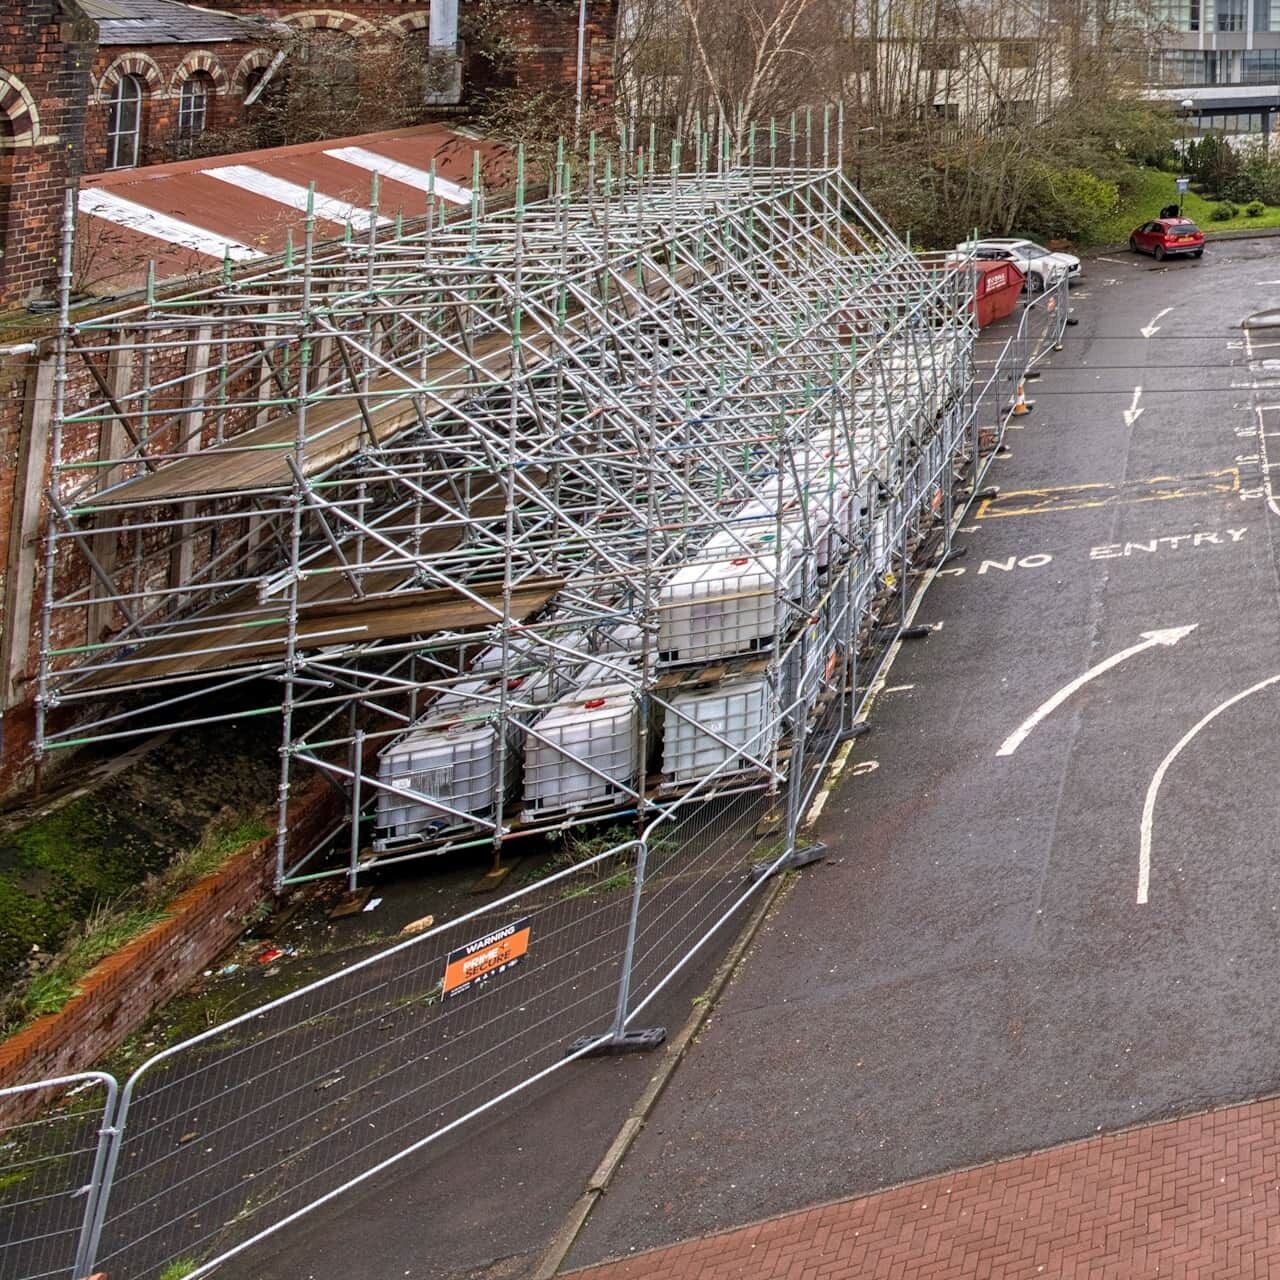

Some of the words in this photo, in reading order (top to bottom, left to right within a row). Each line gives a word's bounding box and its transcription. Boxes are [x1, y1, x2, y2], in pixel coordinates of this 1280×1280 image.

[977, 553, 1052, 575] NO
[1089, 527, 1248, 560] ENTRY
[466, 925, 516, 954] WARNING
[466, 950, 511, 978] SECURE
